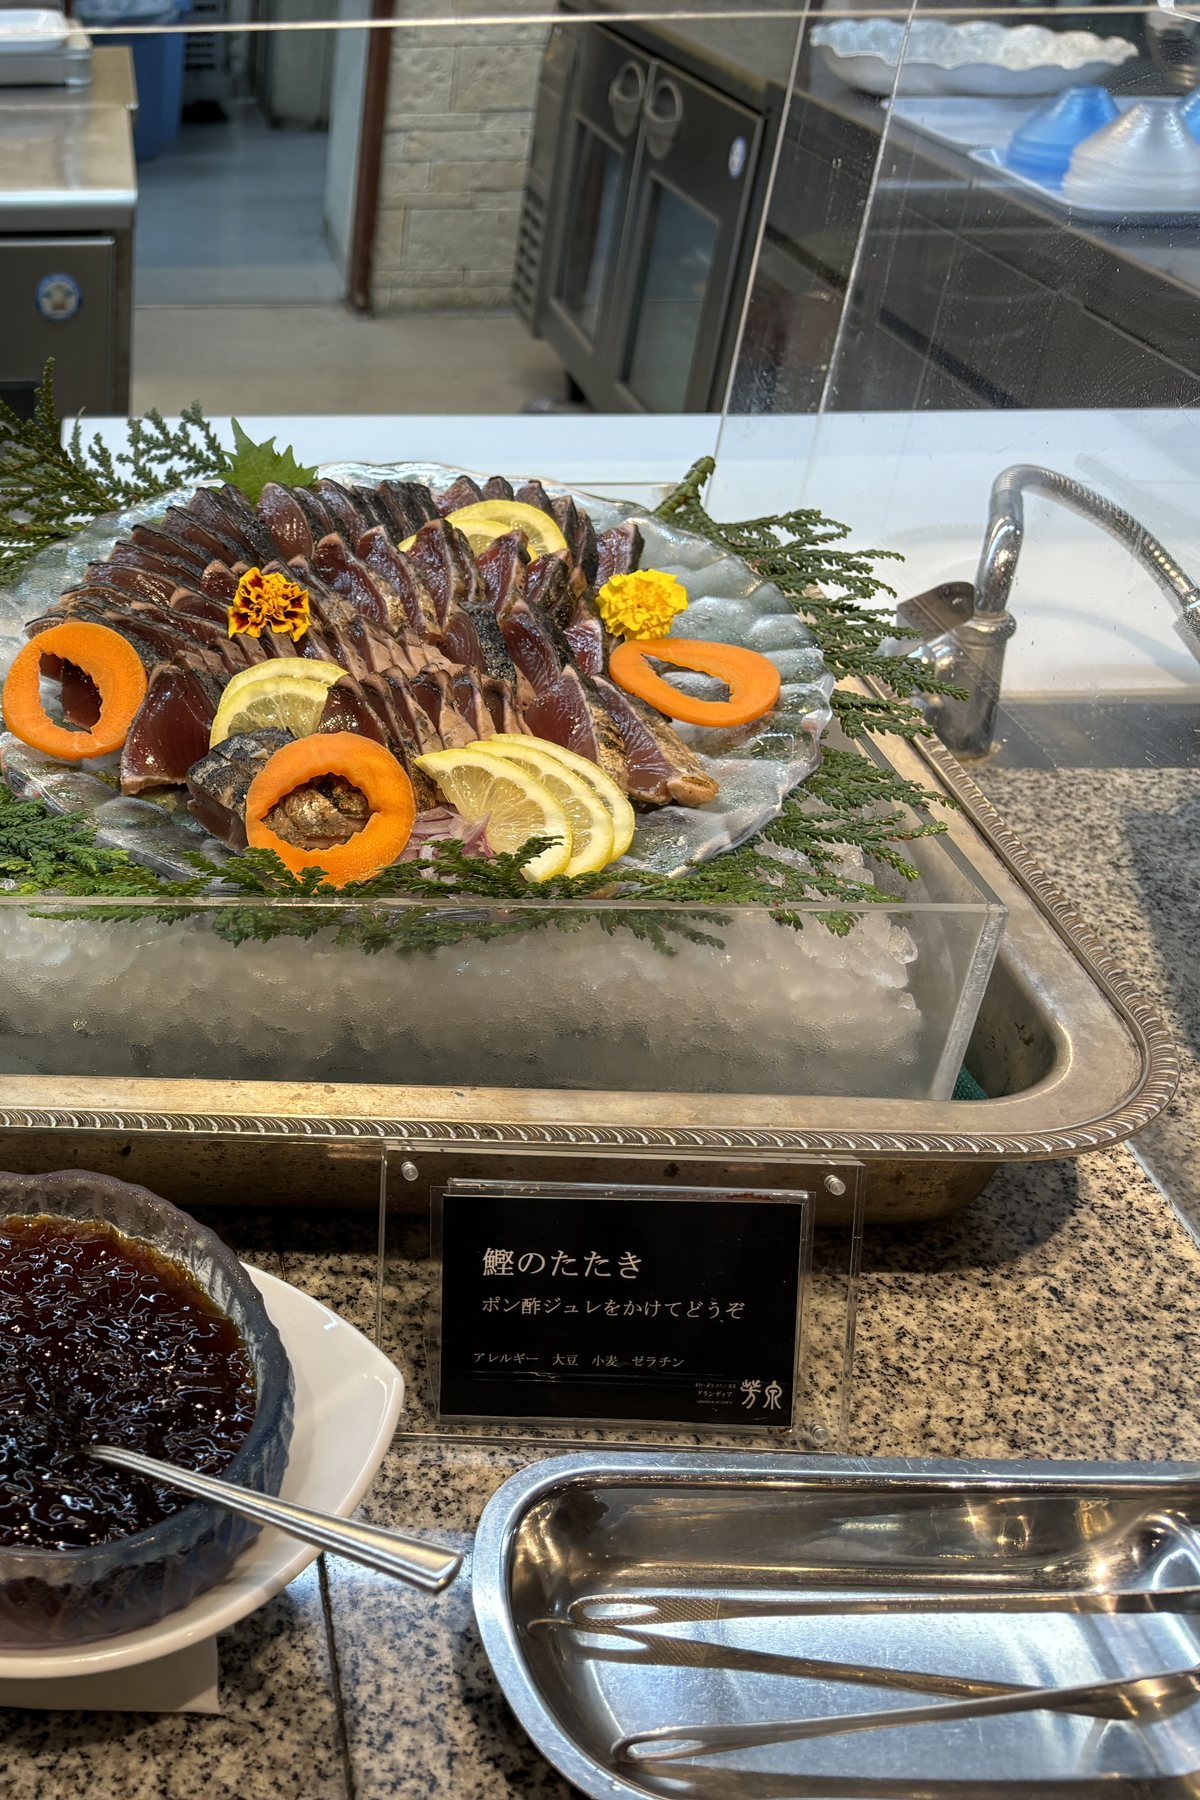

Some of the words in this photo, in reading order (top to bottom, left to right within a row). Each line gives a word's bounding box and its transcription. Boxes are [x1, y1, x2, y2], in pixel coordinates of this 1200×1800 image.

[482, 1247, 642, 1279] 鰹のたたき
[482, 1296, 745, 1319] ポン酢ジュレをかけてどうぞ
[473, 1352, 539, 1365] アレルギー
[552, 1353, 578, 1367] 大豆
[591, 1354, 618, 1368] 小麦
[631, 1355, 685, 1368] ゼラチン
